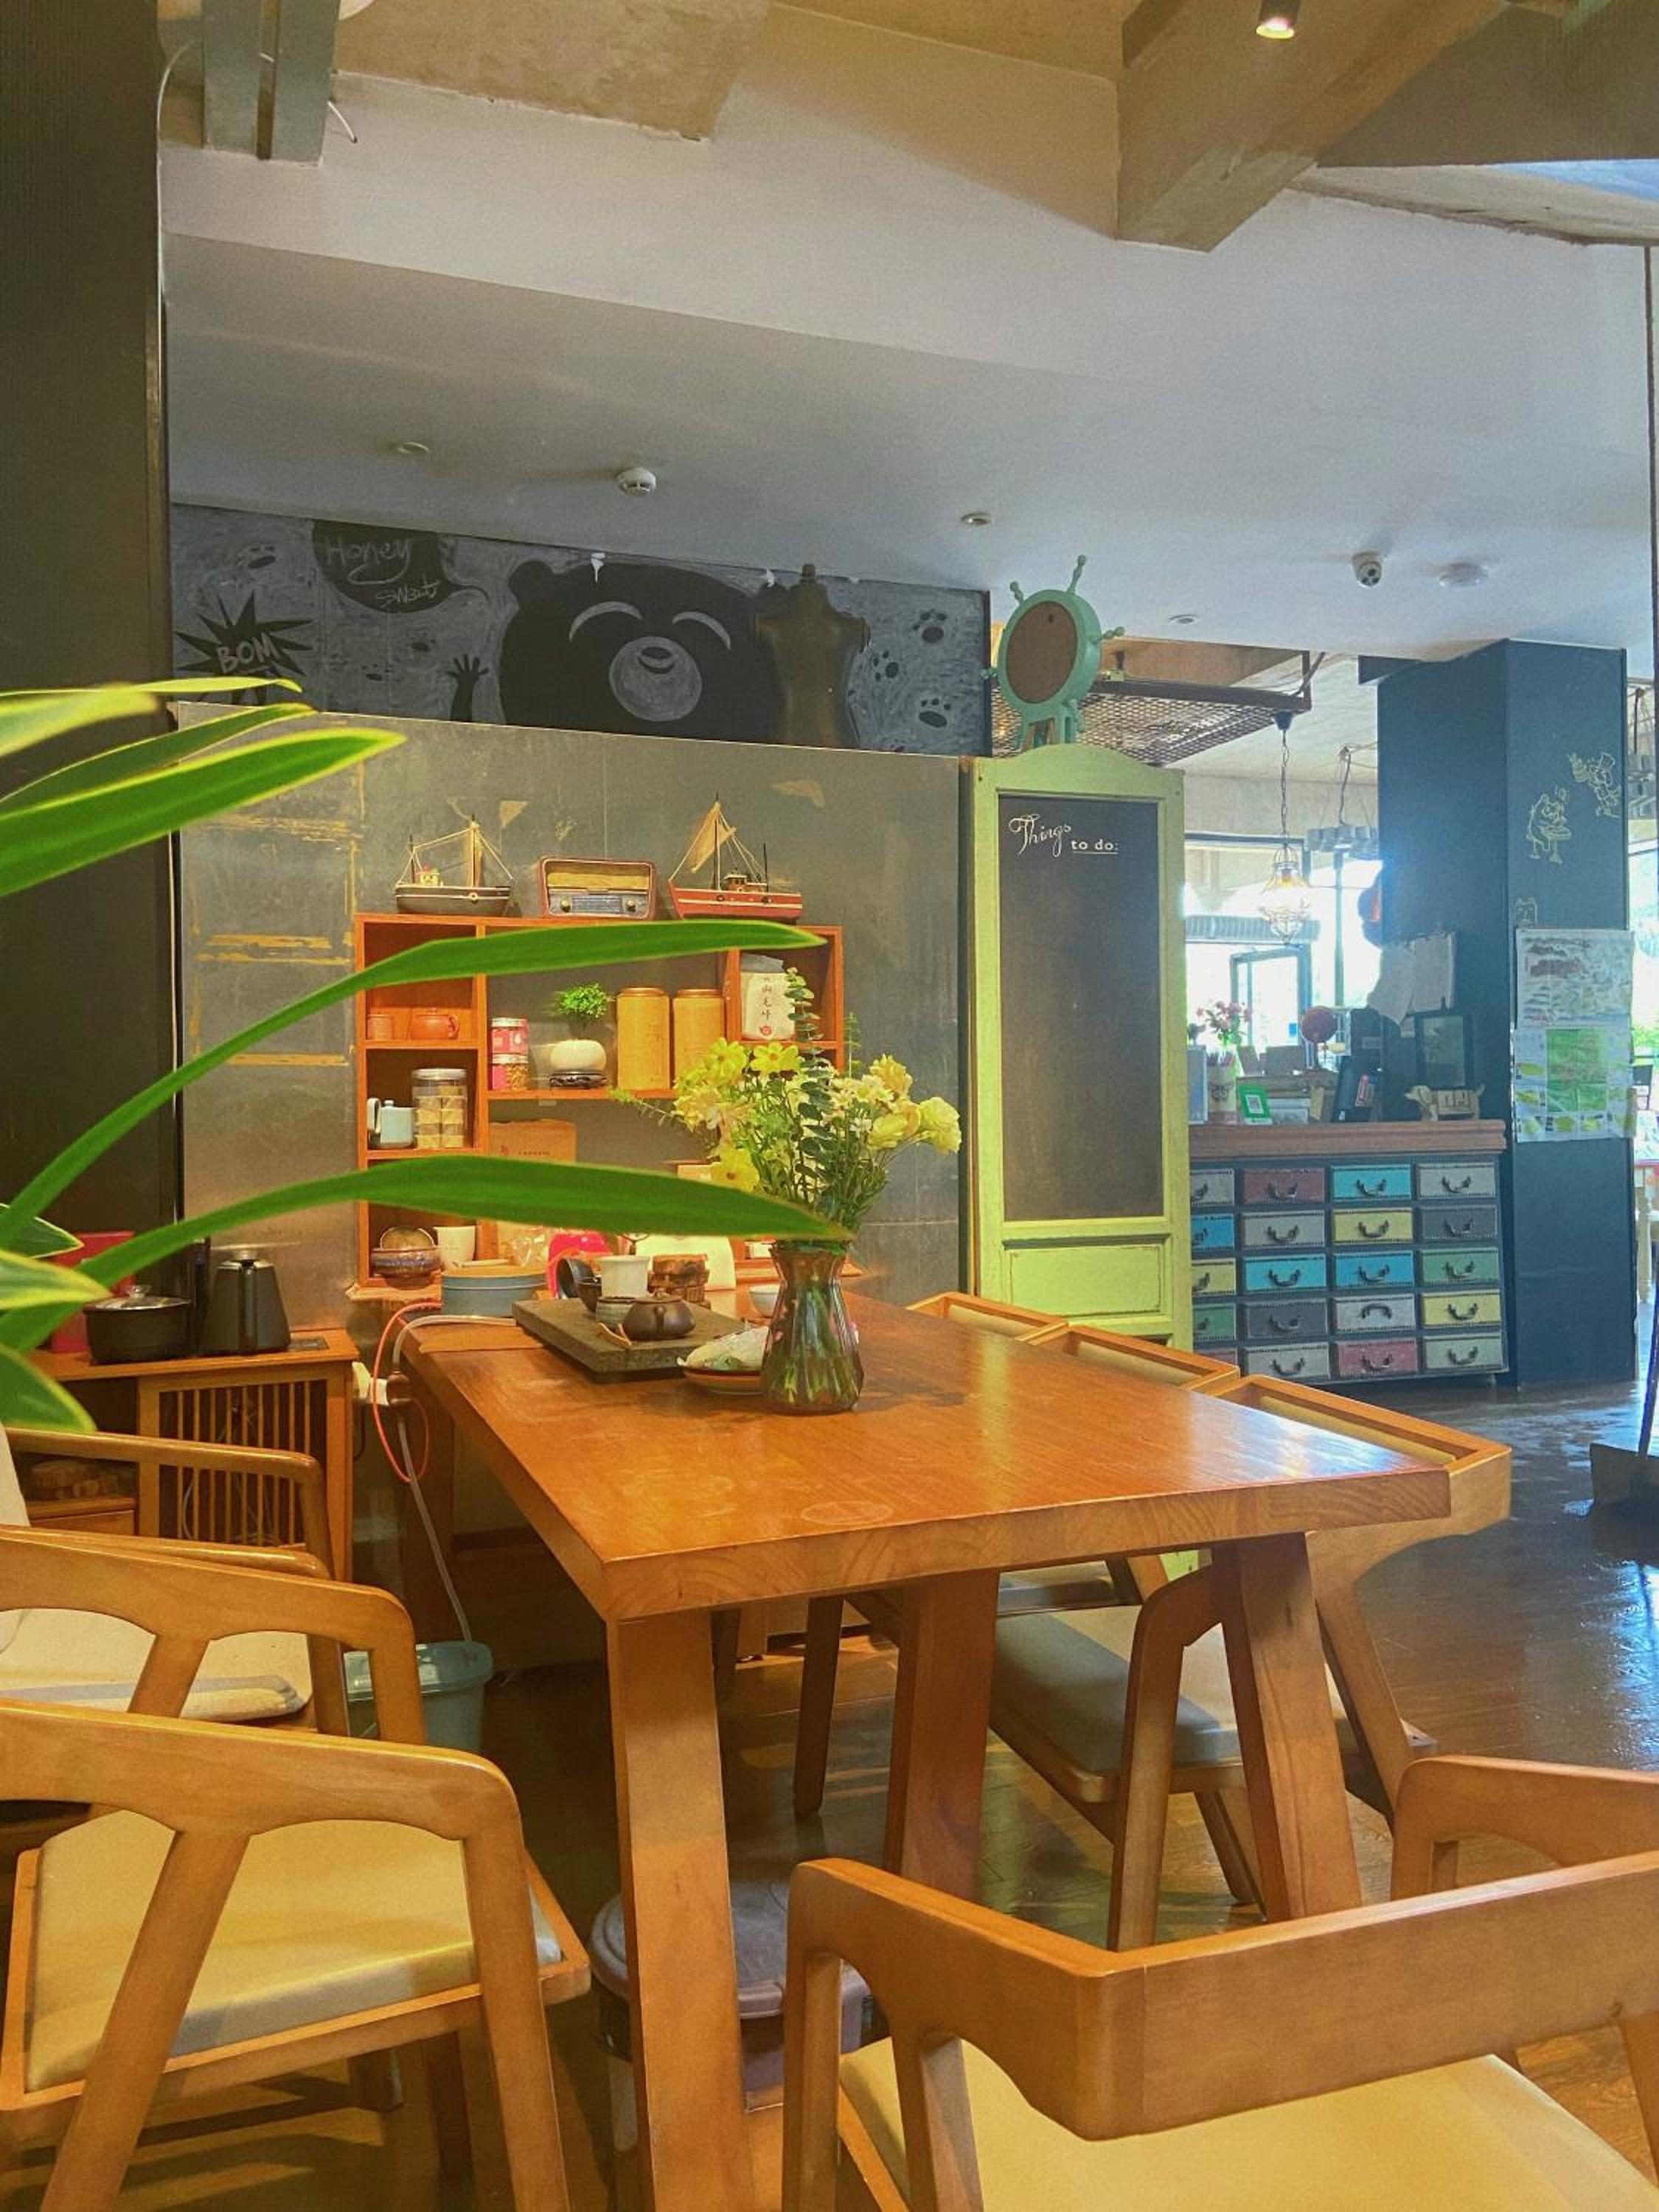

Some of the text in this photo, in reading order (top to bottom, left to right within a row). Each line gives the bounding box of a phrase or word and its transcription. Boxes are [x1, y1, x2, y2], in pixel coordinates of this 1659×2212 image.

[324, 537, 411, 585] Honey
[218, 633, 281, 674] BOM
[1009, 814, 1071, 858] Things
[1071, 840, 1088, 850] to
